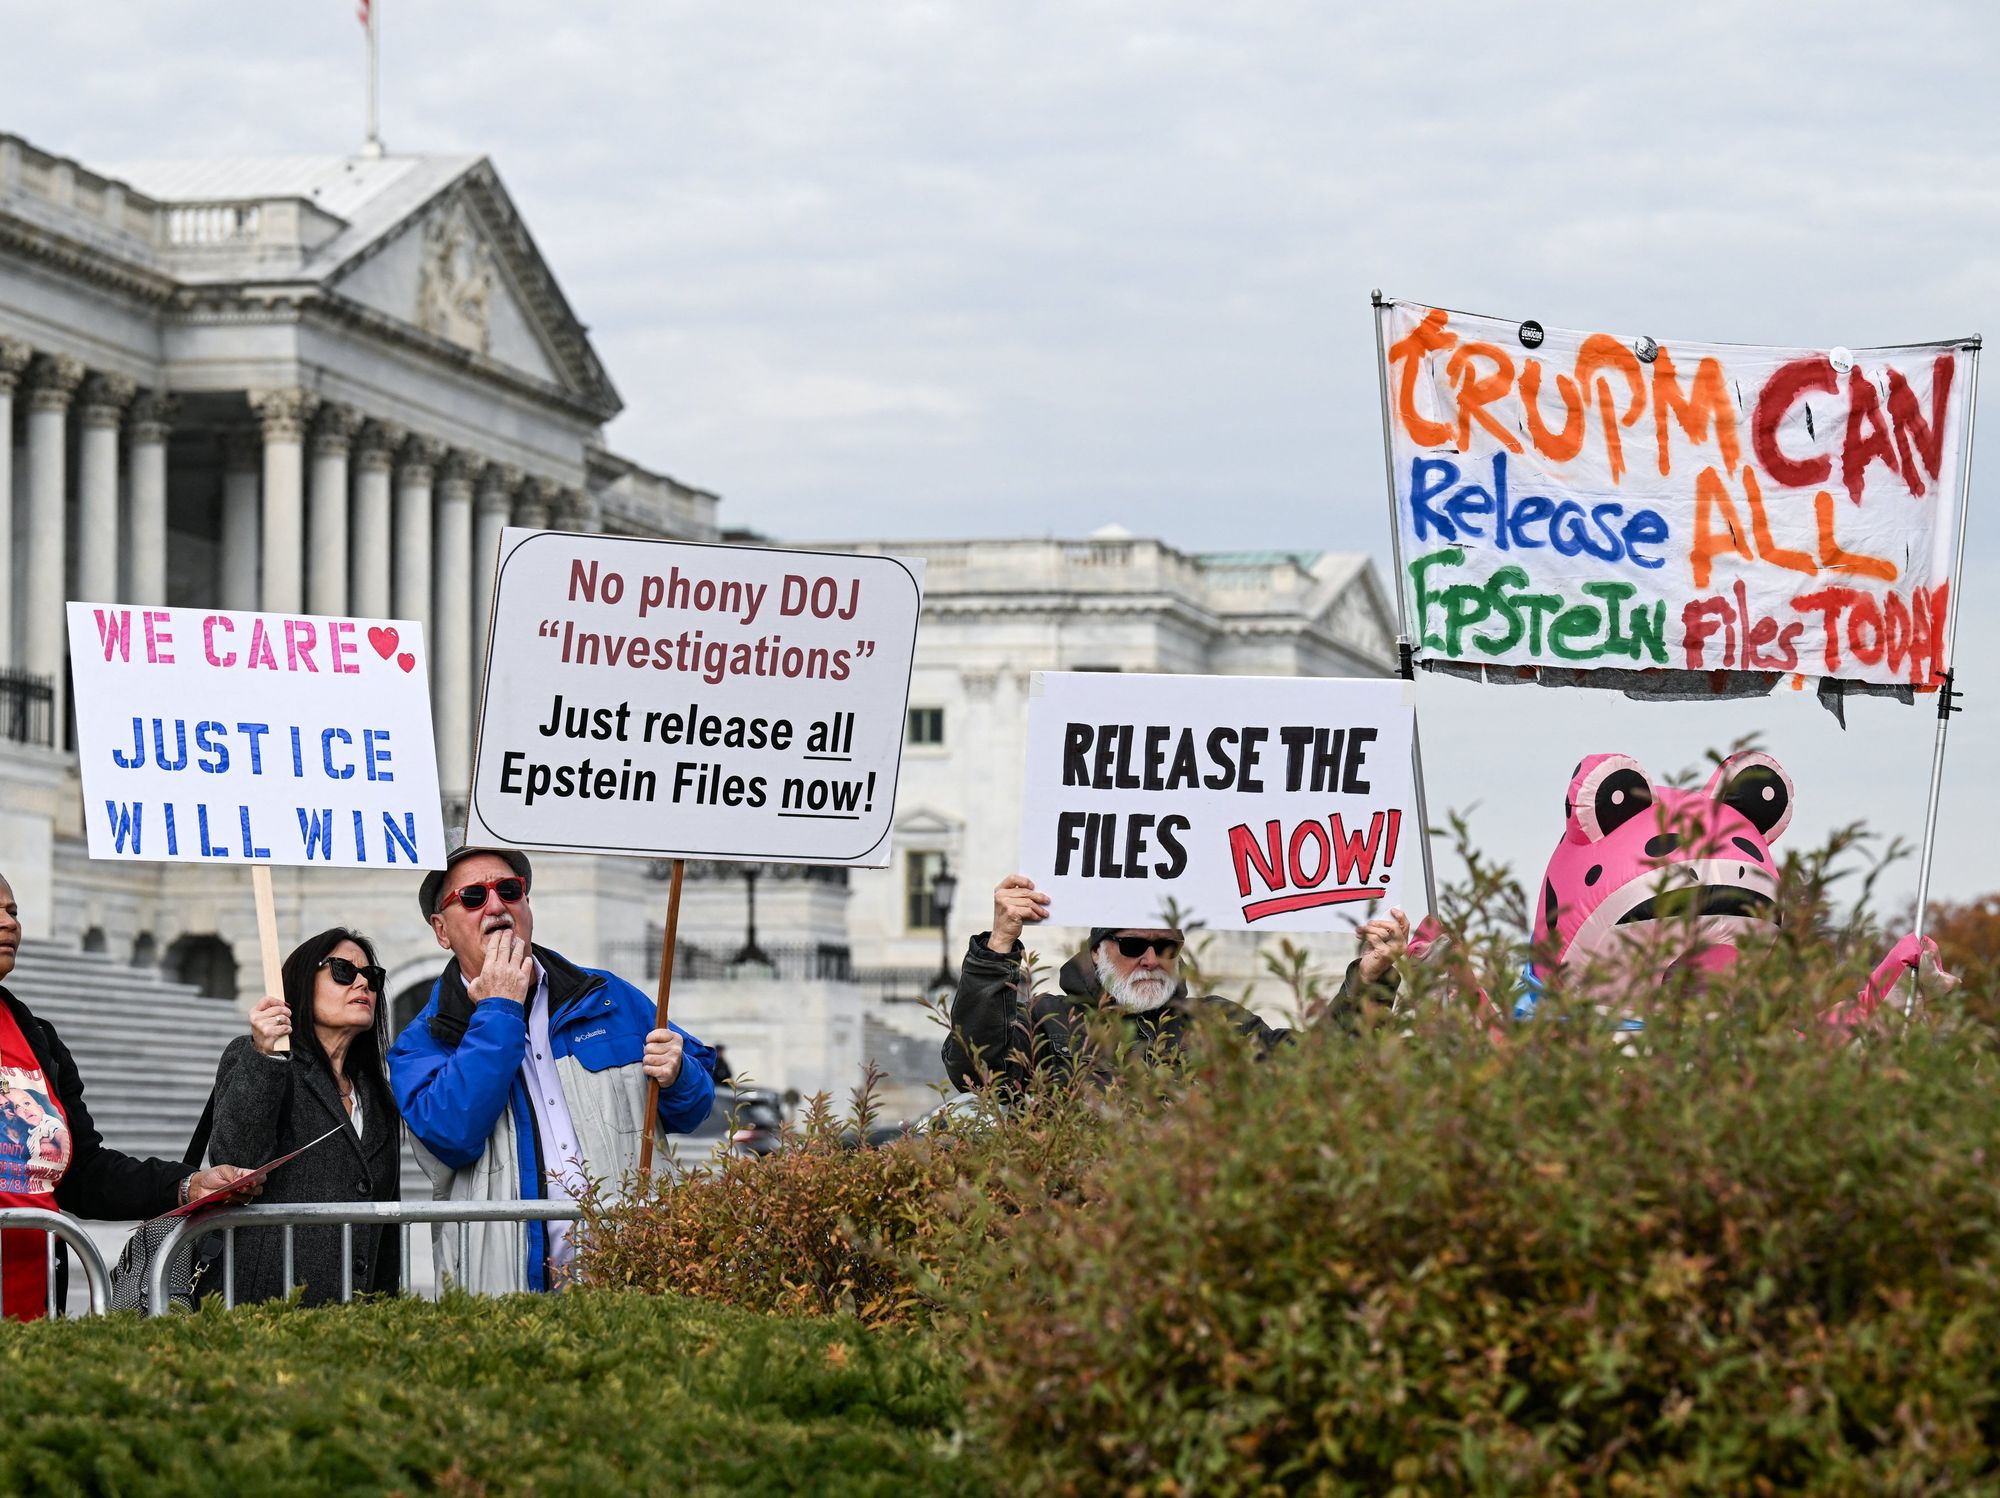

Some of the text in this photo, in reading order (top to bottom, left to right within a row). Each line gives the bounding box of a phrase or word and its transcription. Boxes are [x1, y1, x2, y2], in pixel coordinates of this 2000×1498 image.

[1752, 354, 1955, 508] CAN
[1409, 450, 1898, 590] Release ALL
[569, 559, 861, 625] No phony DOJ
[1682, 578, 1804, 672] Files
[93, 609, 360, 674] WE CARE
[538, 619, 876, 685] “Investigations”
[112, 717, 394, 782] JUSTICE
[539, 695, 855, 753] Just release all
[499, 751, 877, 813] Epstein Files now!
[1062, 722, 1379, 795] RELEASE THE
[105, 800, 419, 864] WILL WIN
[1054, 809, 1402, 897] FILES NOW!
[580, 1029, 606, 1040] Columbia
